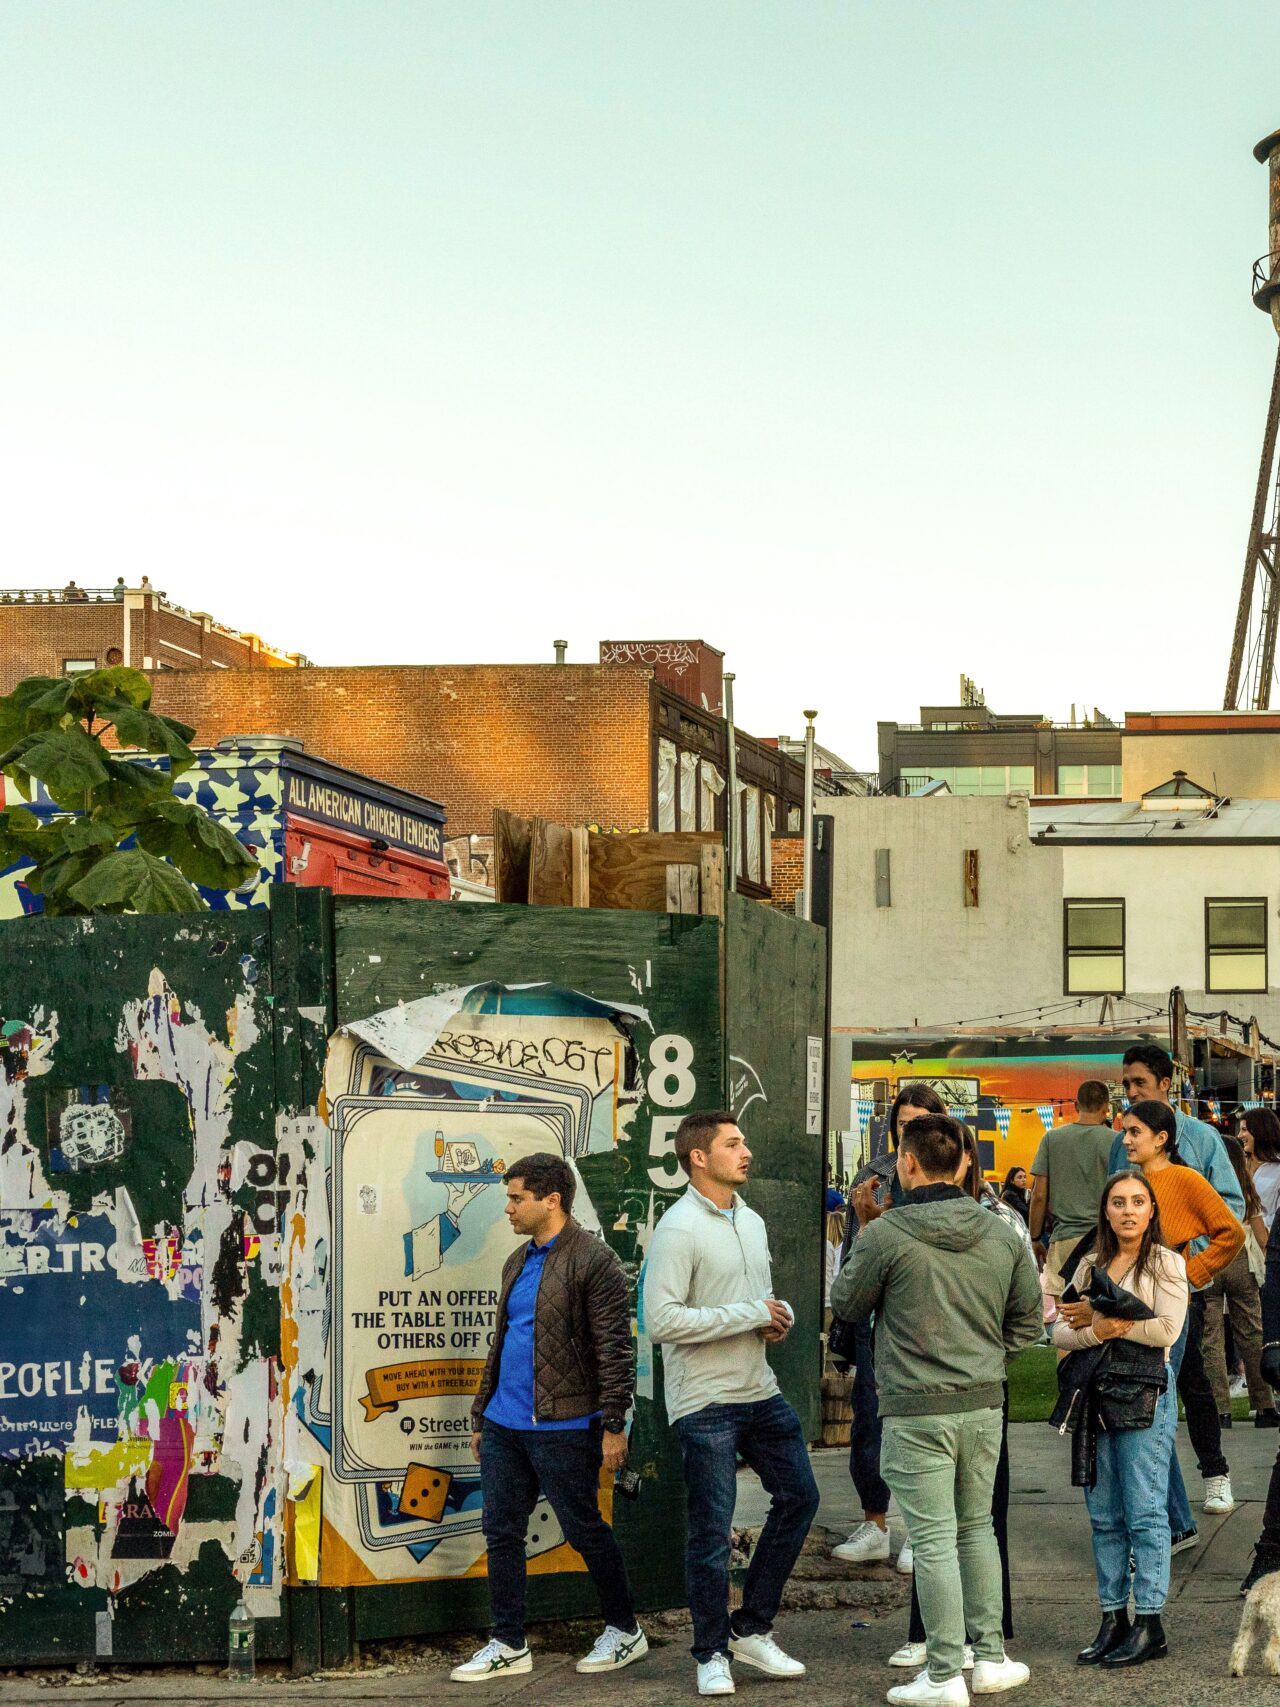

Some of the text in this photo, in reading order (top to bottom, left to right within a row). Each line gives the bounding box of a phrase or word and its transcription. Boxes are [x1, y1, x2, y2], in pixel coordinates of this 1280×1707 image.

[288, 776, 440, 854] ALL AMERICAN CHICKEN TENDERS
[378, 1290, 499, 1307] PUT AN OFFER
[351, 1311, 496, 1328] THE TABLE THAT
[377, 1332, 446, 1350] OTHERS
[450, 1332, 481, 1348] OFF
[383, 1367, 483, 1382] MOVE AHEAD WITH YOUR BEST
[396, 1384, 410, 1392] BUY
[412, 1382, 429, 1390] WITH
[437, 1380, 478, 1388] STREETEASY
[409, 1443, 423, 1451] WIN
[434, 1442, 452, 1450] GAME
[452, 1443, 460, 1451] of
